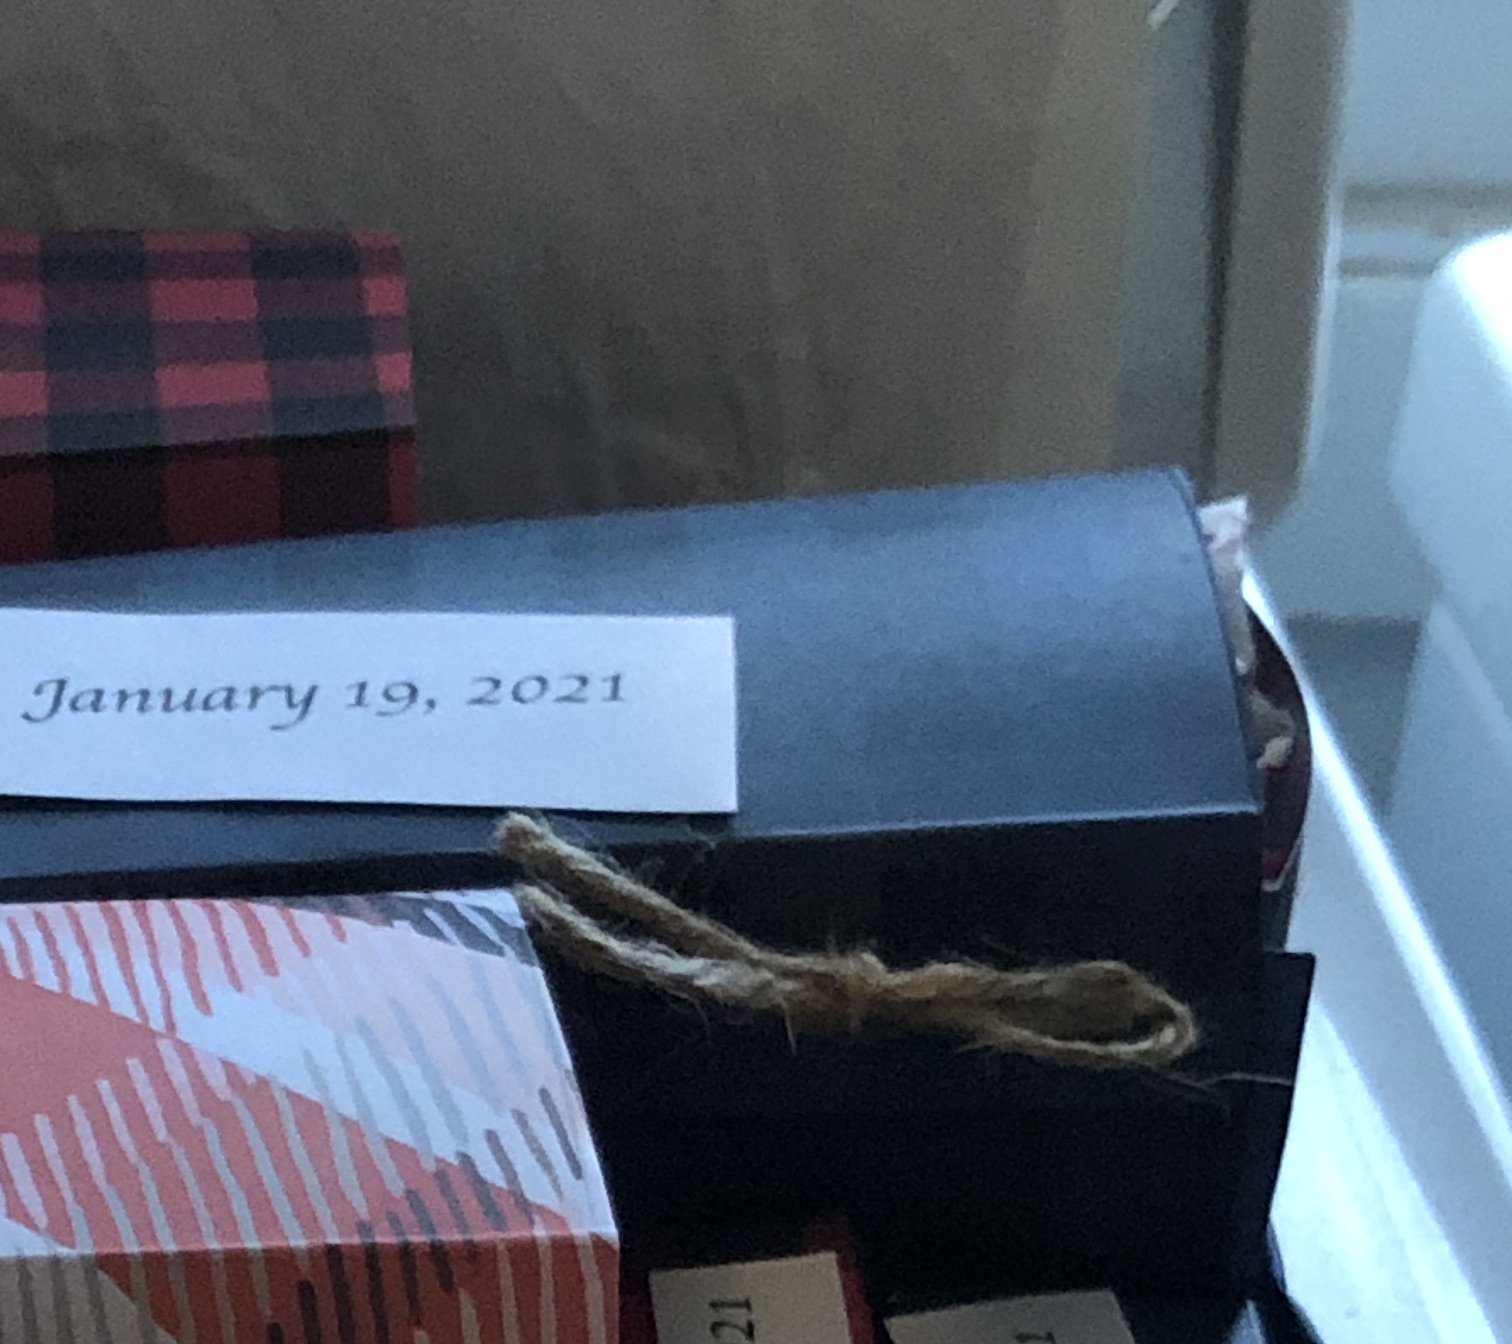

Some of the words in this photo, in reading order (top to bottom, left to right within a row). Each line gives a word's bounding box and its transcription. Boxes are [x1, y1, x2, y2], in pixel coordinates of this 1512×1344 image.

[21, 677, 319, 732] January
[348, 680, 437, 718] 19,
[466, 672, 623, 706] 2021
